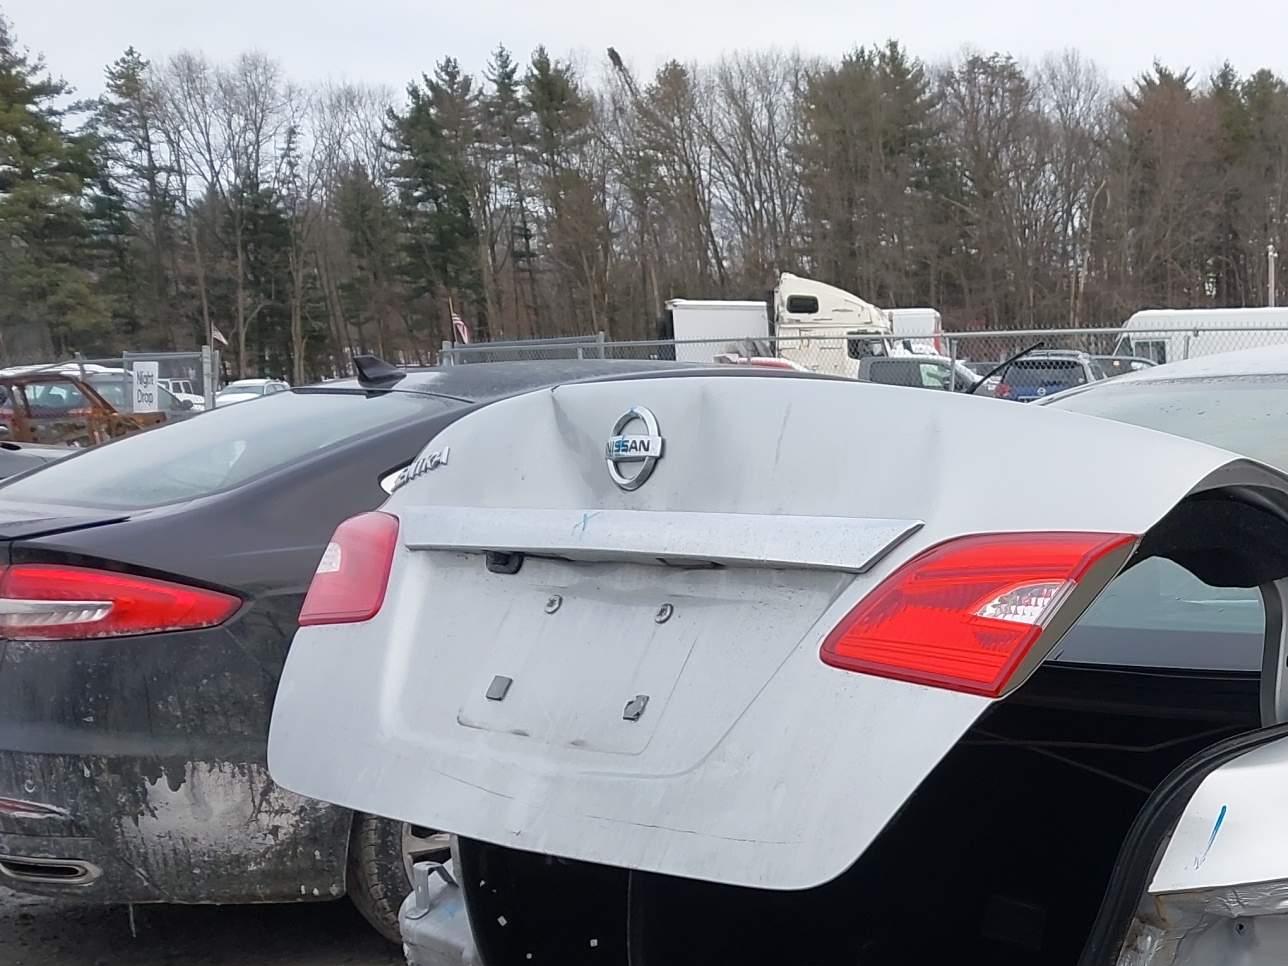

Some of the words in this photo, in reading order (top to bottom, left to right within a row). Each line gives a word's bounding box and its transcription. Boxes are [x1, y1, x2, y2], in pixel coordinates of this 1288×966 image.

[136, 370, 154, 388] Night
[136, 389, 154, 406] Drop
[606, 439, 651, 455] NISSAN
